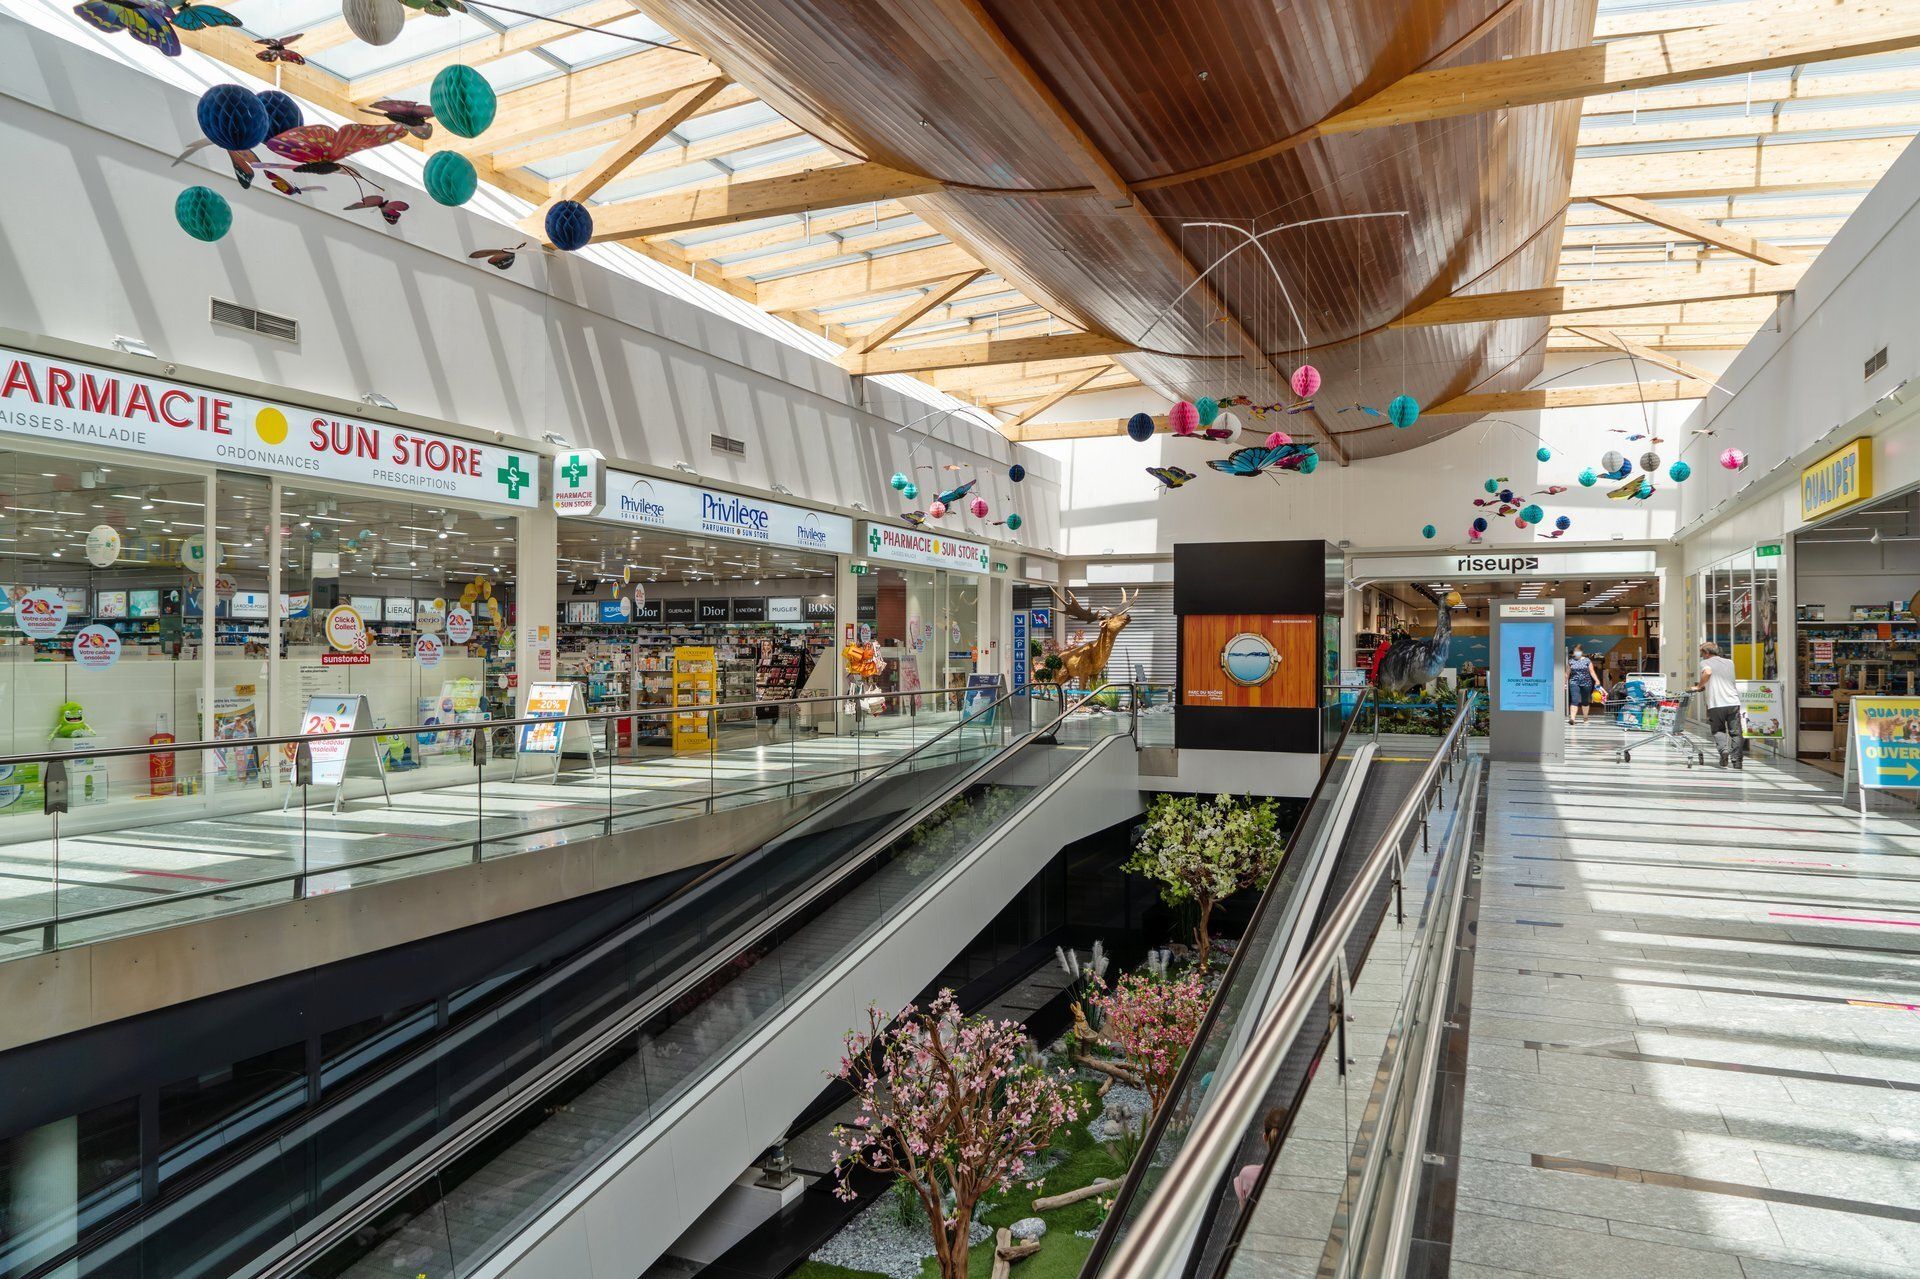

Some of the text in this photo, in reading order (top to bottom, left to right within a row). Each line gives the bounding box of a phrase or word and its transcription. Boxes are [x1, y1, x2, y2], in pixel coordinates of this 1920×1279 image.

[1, 360, 233, 435] ARMACIE
[0, 410, 146, 444] AISSES-MALADIE
[309, 418, 483, 478] SUN STORE
[217, 445, 320, 471] ORDONNANCES
[373, 469, 457, 491] PRESCRIPTIONS
[1805, 452, 1856, 512] QUALIPET
[555, 491, 593, 499] PHARMACIE
[621, 512, 639, 520] SOINS
[702, 493, 769, 530] Privilège
[702, 523, 735, 535] PARFUMERIE
[754, 531, 768, 540] STORE
[883, 530, 931, 553] PHARMACIE
[942, 542, 956, 557] SUN
[958, 545, 979, 560] STORE
[1458, 555, 1524, 574] riseup
[636, 607, 658, 617] Dior
[702, 606, 726, 616] Dior
[808, 603, 835, 613] BOSS
[323, 654, 369, 663] sunstore.ch
[537, 700, 560, 709] -20%
[1866, 707, 1920, 718] QUAIPE
